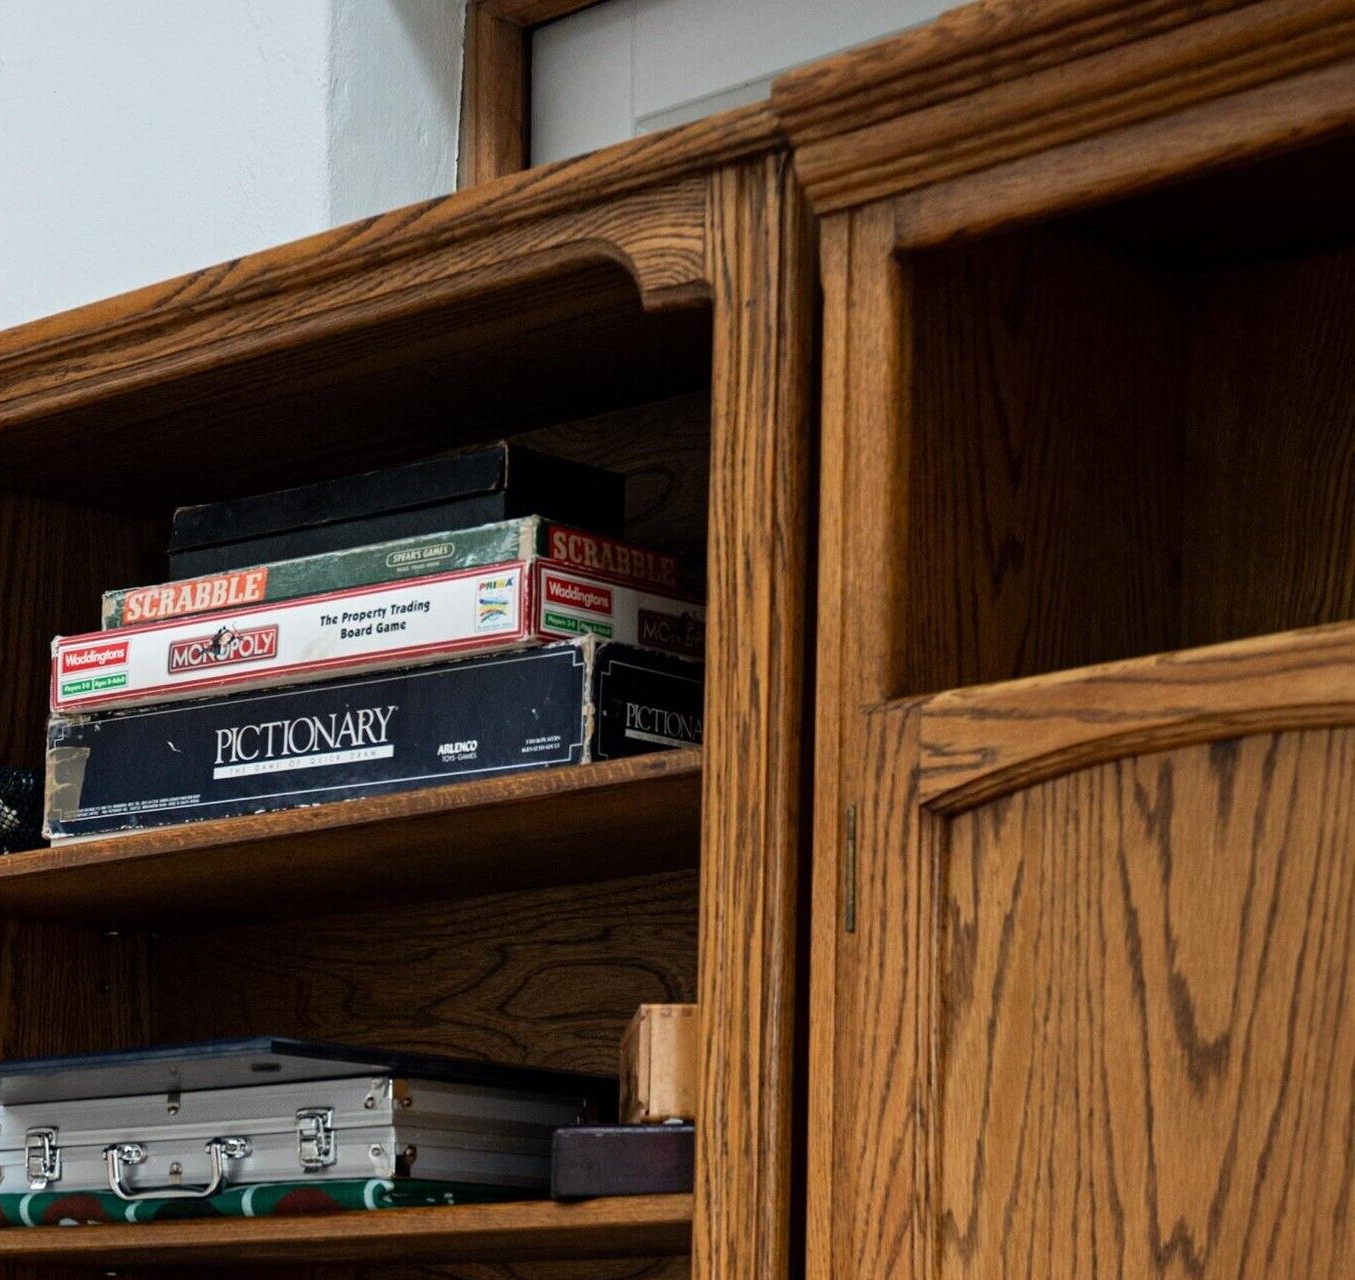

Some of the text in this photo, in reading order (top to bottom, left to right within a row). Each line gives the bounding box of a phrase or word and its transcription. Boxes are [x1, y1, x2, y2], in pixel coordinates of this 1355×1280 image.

[423, 545, 448, 560] GAMES
[553, 531, 676, 584] SCRABBLE
[127, 572, 263, 621] SCRABBLE
[549, 581, 609, 607] Waddingtons
[320, 599, 431, 627] The Property Trading
[340, 619, 406, 639] Board Game
[64, 646, 126, 668] Waddingtons
[214, 705, 395, 765] PICTIONARY
